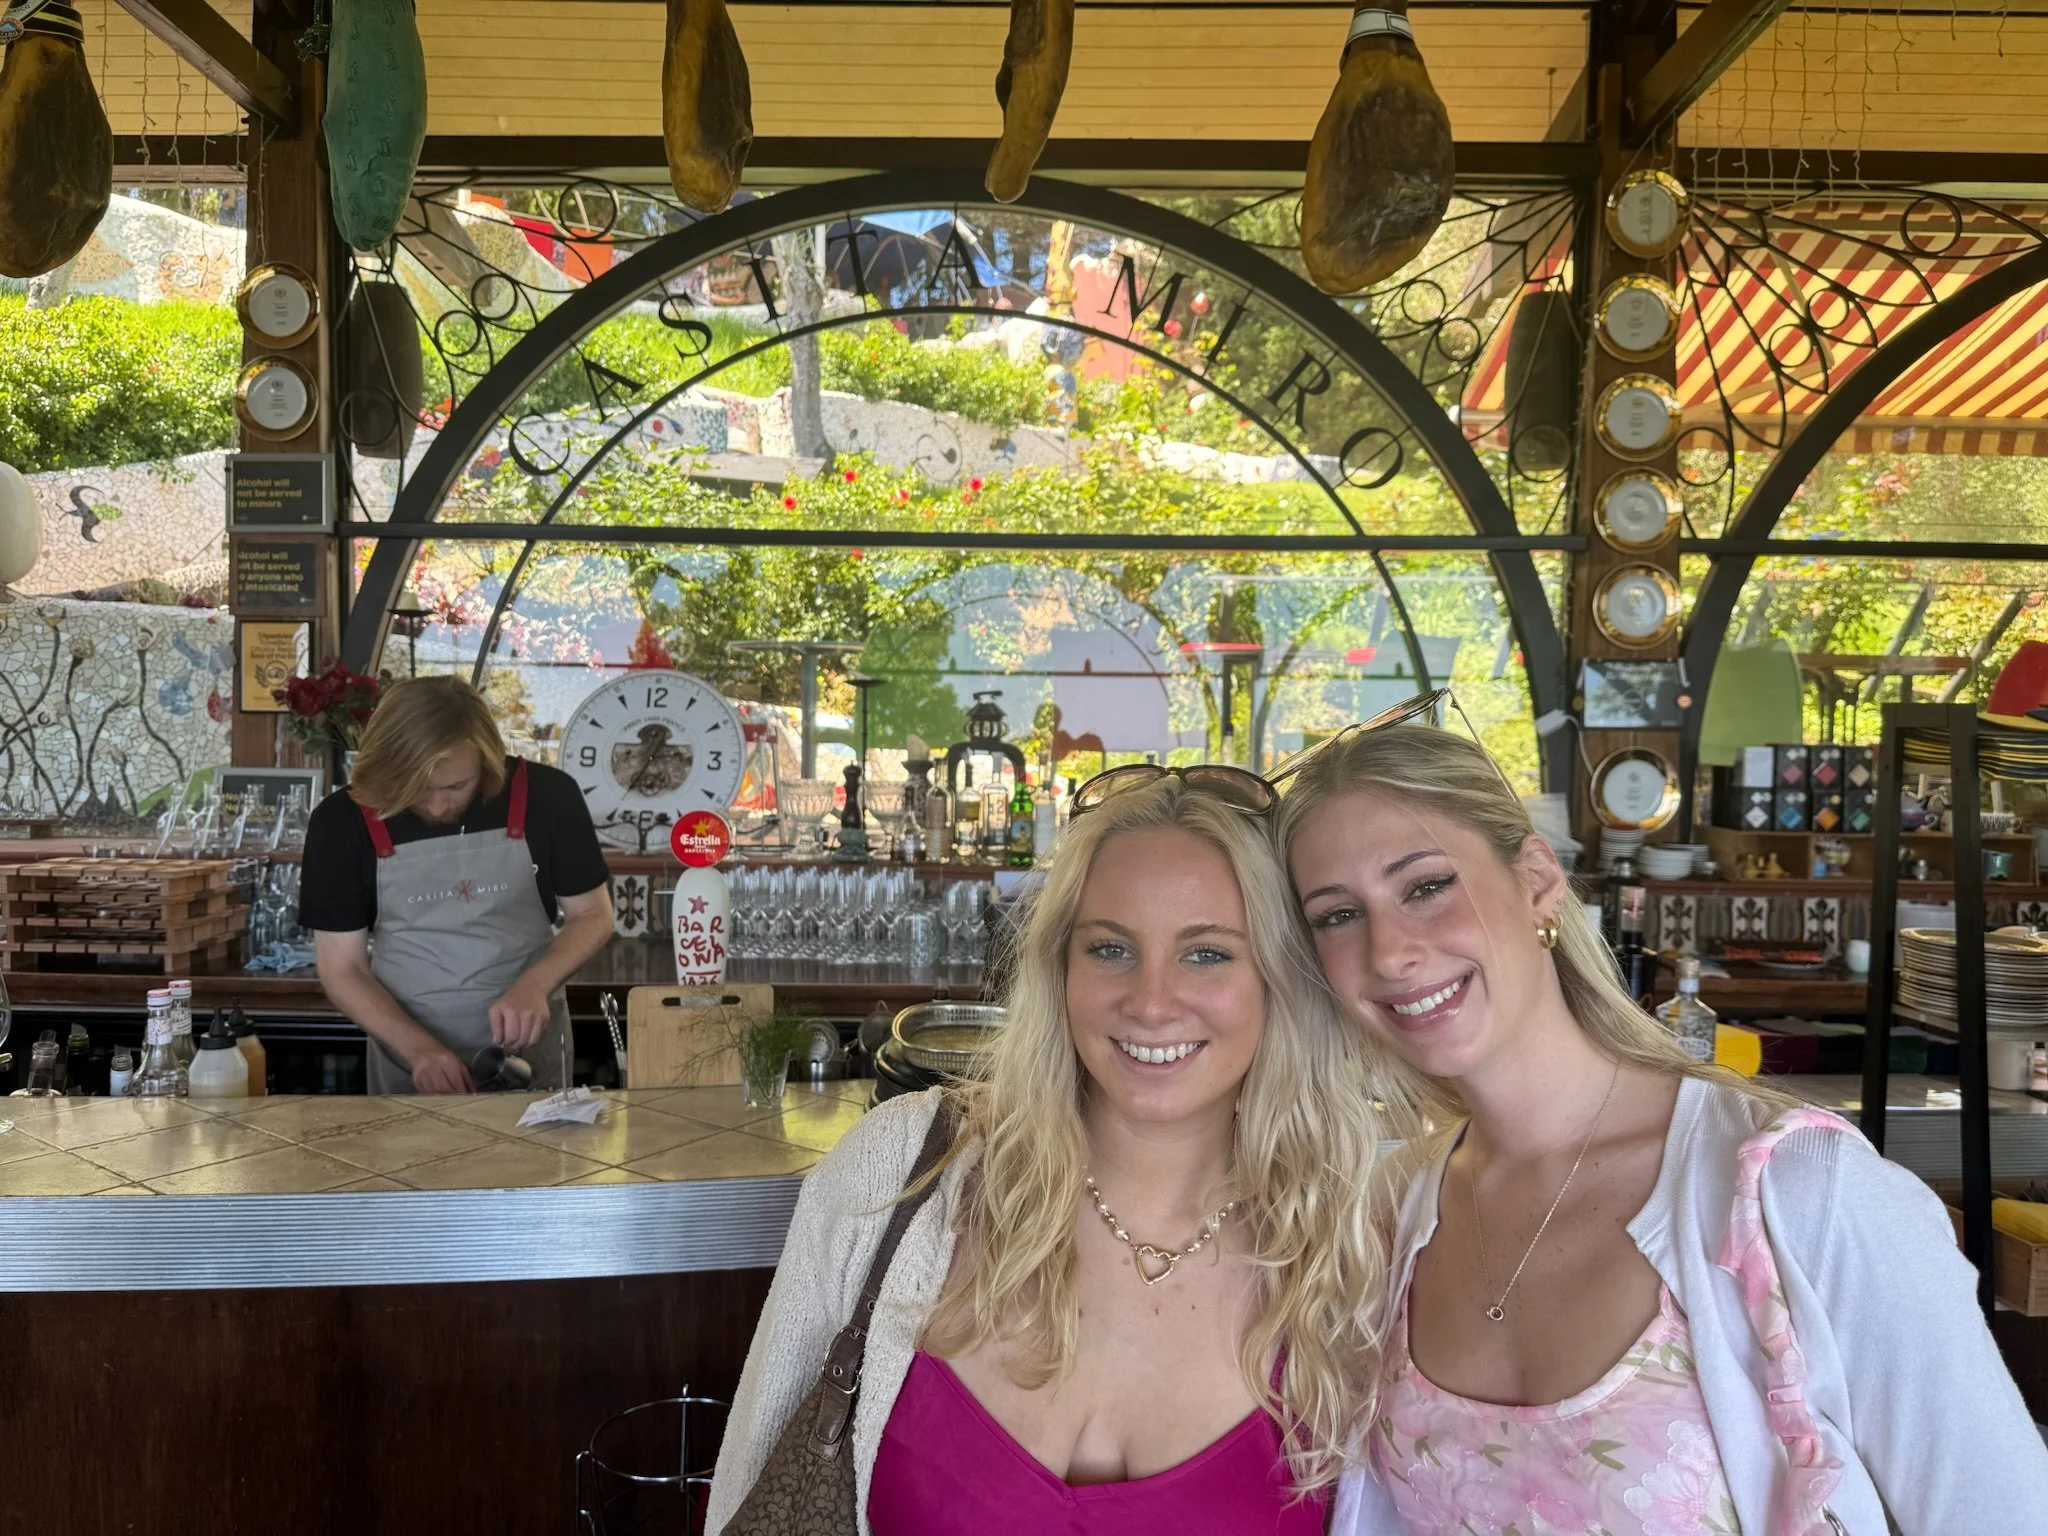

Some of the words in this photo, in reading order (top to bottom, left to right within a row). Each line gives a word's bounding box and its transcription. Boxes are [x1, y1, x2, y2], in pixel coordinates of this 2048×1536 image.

[509, 220, 994, 476] CASITA
[1096, 253, 1404, 489] MIRO
[236, 478, 272, 487] Alcohol
[273, 478, 290, 487] will
[236, 489, 253, 497] not
[255, 489, 267, 497] be
[269, 489, 302, 497] served
[236, 500, 247, 508] to
[249, 500, 282, 508] minors
[272, 552, 288, 560] will
[253, 562, 266, 570] be
[268, 562, 300, 571] served
[247, 573, 281, 582] anyone
[284, 573, 304, 581] who
[245, 583, 299, 592] intoxicated
[646, 687, 669, 708] 12
[579, 746, 597, 768] 9
[707, 750, 722, 770] 3
[680, 833, 721, 846] Estrella
[407, 889, 453, 904] CASITA
[477, 882, 509, 894] MIRO
[678, 915, 725, 934] BAR
